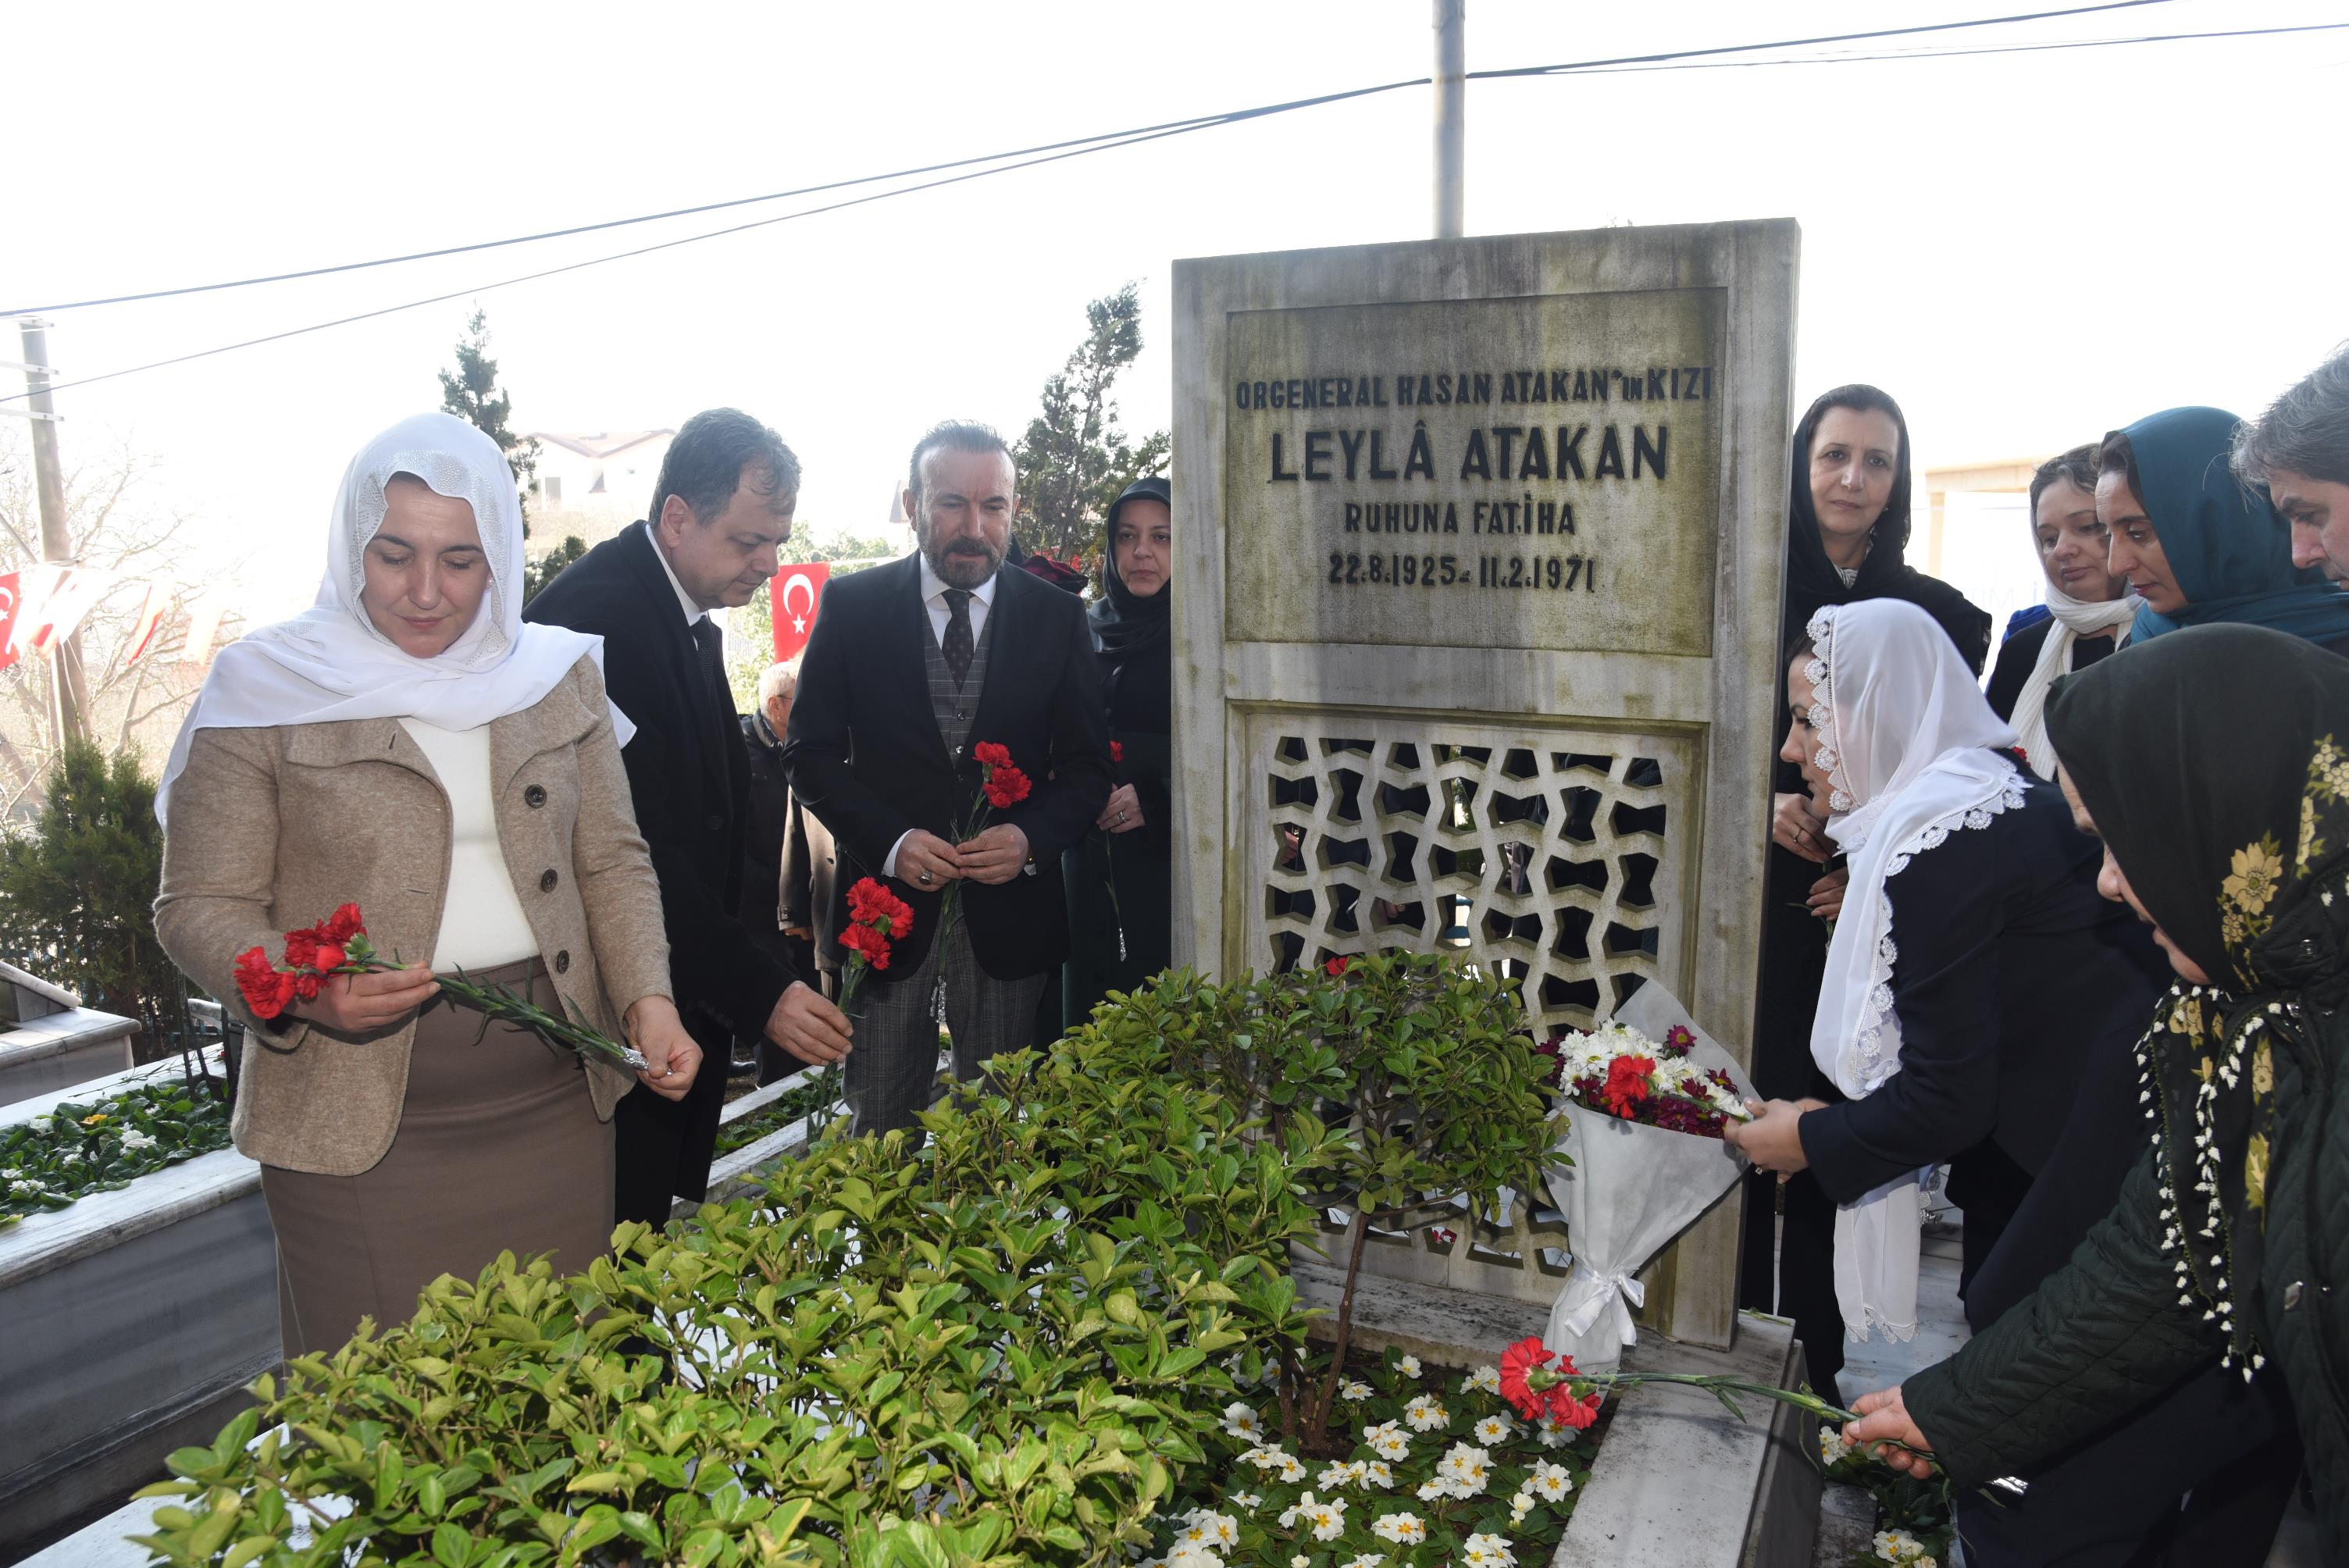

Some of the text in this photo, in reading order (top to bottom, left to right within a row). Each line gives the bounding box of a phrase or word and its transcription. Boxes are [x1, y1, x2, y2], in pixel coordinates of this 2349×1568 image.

[1236, 375, 1388, 409] ORGENERAL
[1398, 372, 1491, 405] HASAN
[1647, 367, 1711, 401] KIZI
[1271, 419, 1666, 481] LEYLÂ ATAKAN
[1345, 494, 1576, 535] RUHUNA FATİHA
